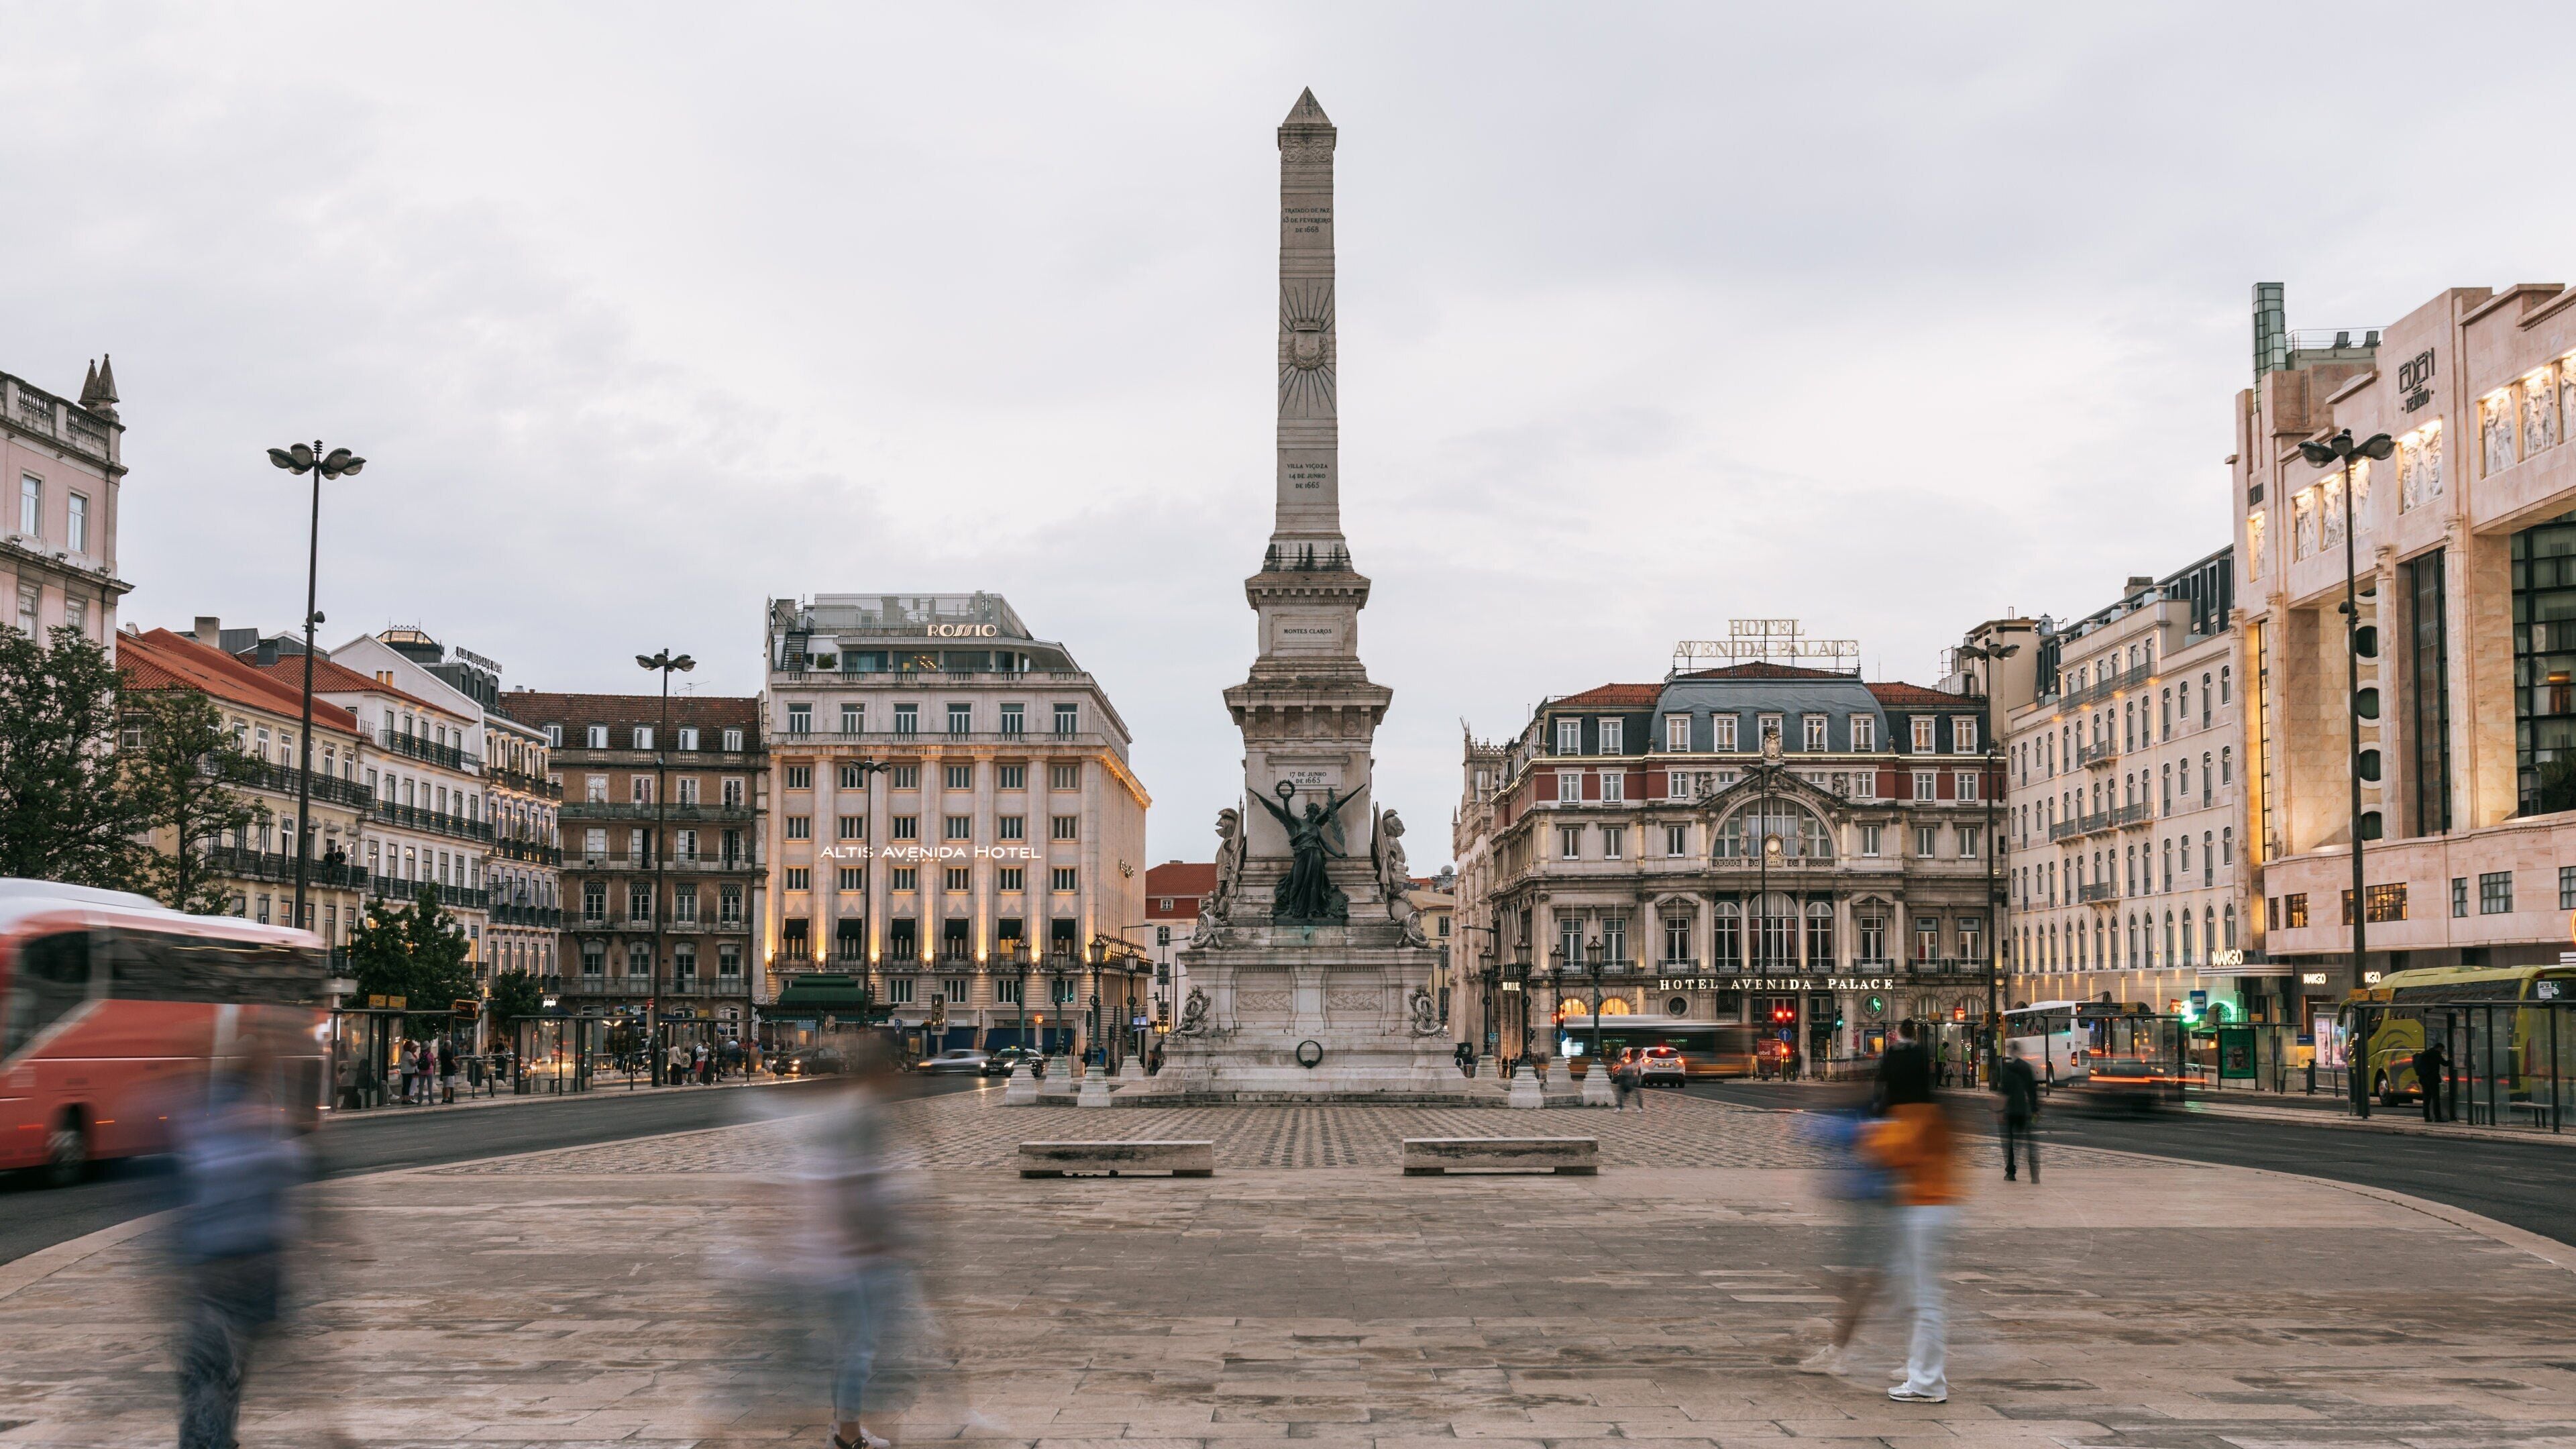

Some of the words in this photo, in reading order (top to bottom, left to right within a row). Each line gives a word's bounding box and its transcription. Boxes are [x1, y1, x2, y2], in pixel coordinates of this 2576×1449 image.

[927, 624, 997, 637] ROSSIO
[1729, 619, 1805, 636] HOTEL
[1673, 641, 1769, 657] AVENIDA
[1777, 640, 1859, 657] PALACE
[820, 846, 874, 859] ALTIS
[881, 846, 967, 859] AVENIDA
[974, 845, 1042, 859] HOTEL
[2212, 949, 2243, 966] MANGO
[2303, 973, 2326, 984] MANGO
[2364, 971, 2381, 983] NGO
[1660, 979, 1718, 990] HOTEL
[1731, 978, 1812, 990] AVENIDA
[1827, 978, 1894, 990] PALACE
